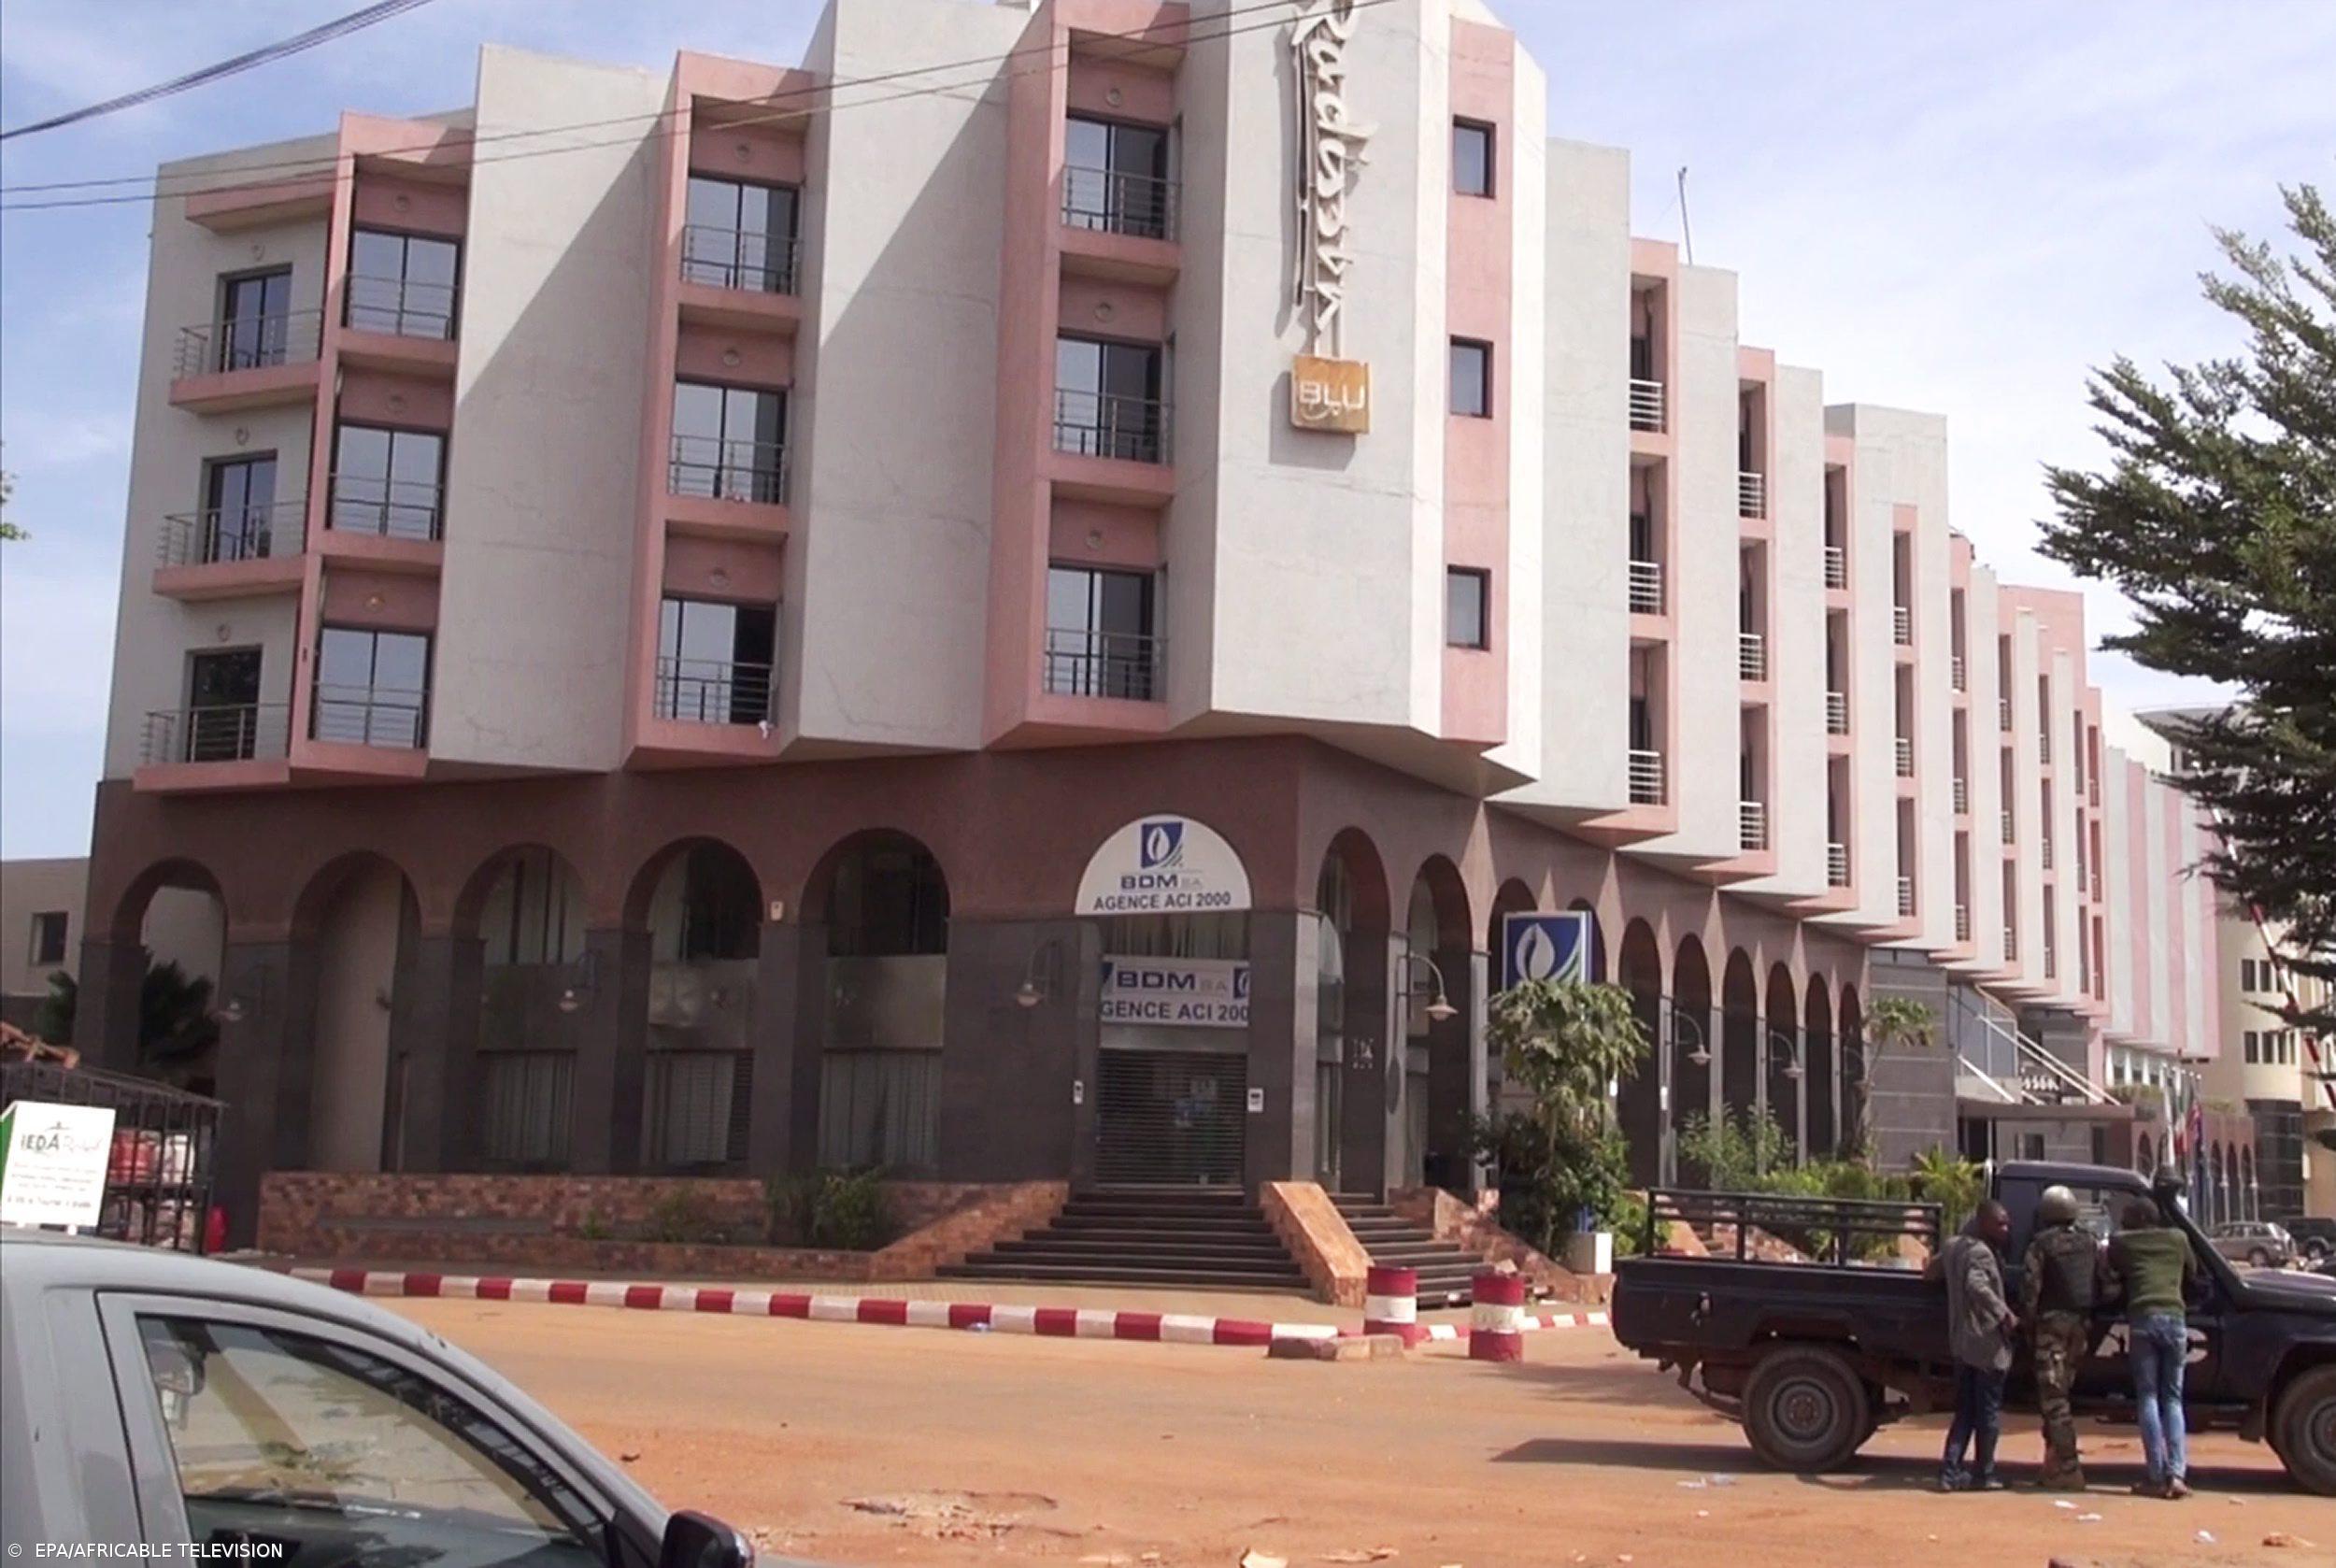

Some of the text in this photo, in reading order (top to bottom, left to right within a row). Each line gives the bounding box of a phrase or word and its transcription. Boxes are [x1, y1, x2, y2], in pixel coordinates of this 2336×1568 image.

[1300, 380, 1365, 409] BLU
[1121, 874, 1178, 889] BDM
[1093, 891, 1232, 910] AGENCE ACI 2000
[1117, 970, 1196, 991] BDM
[1178, 1003, 1212, 1020] ACI
